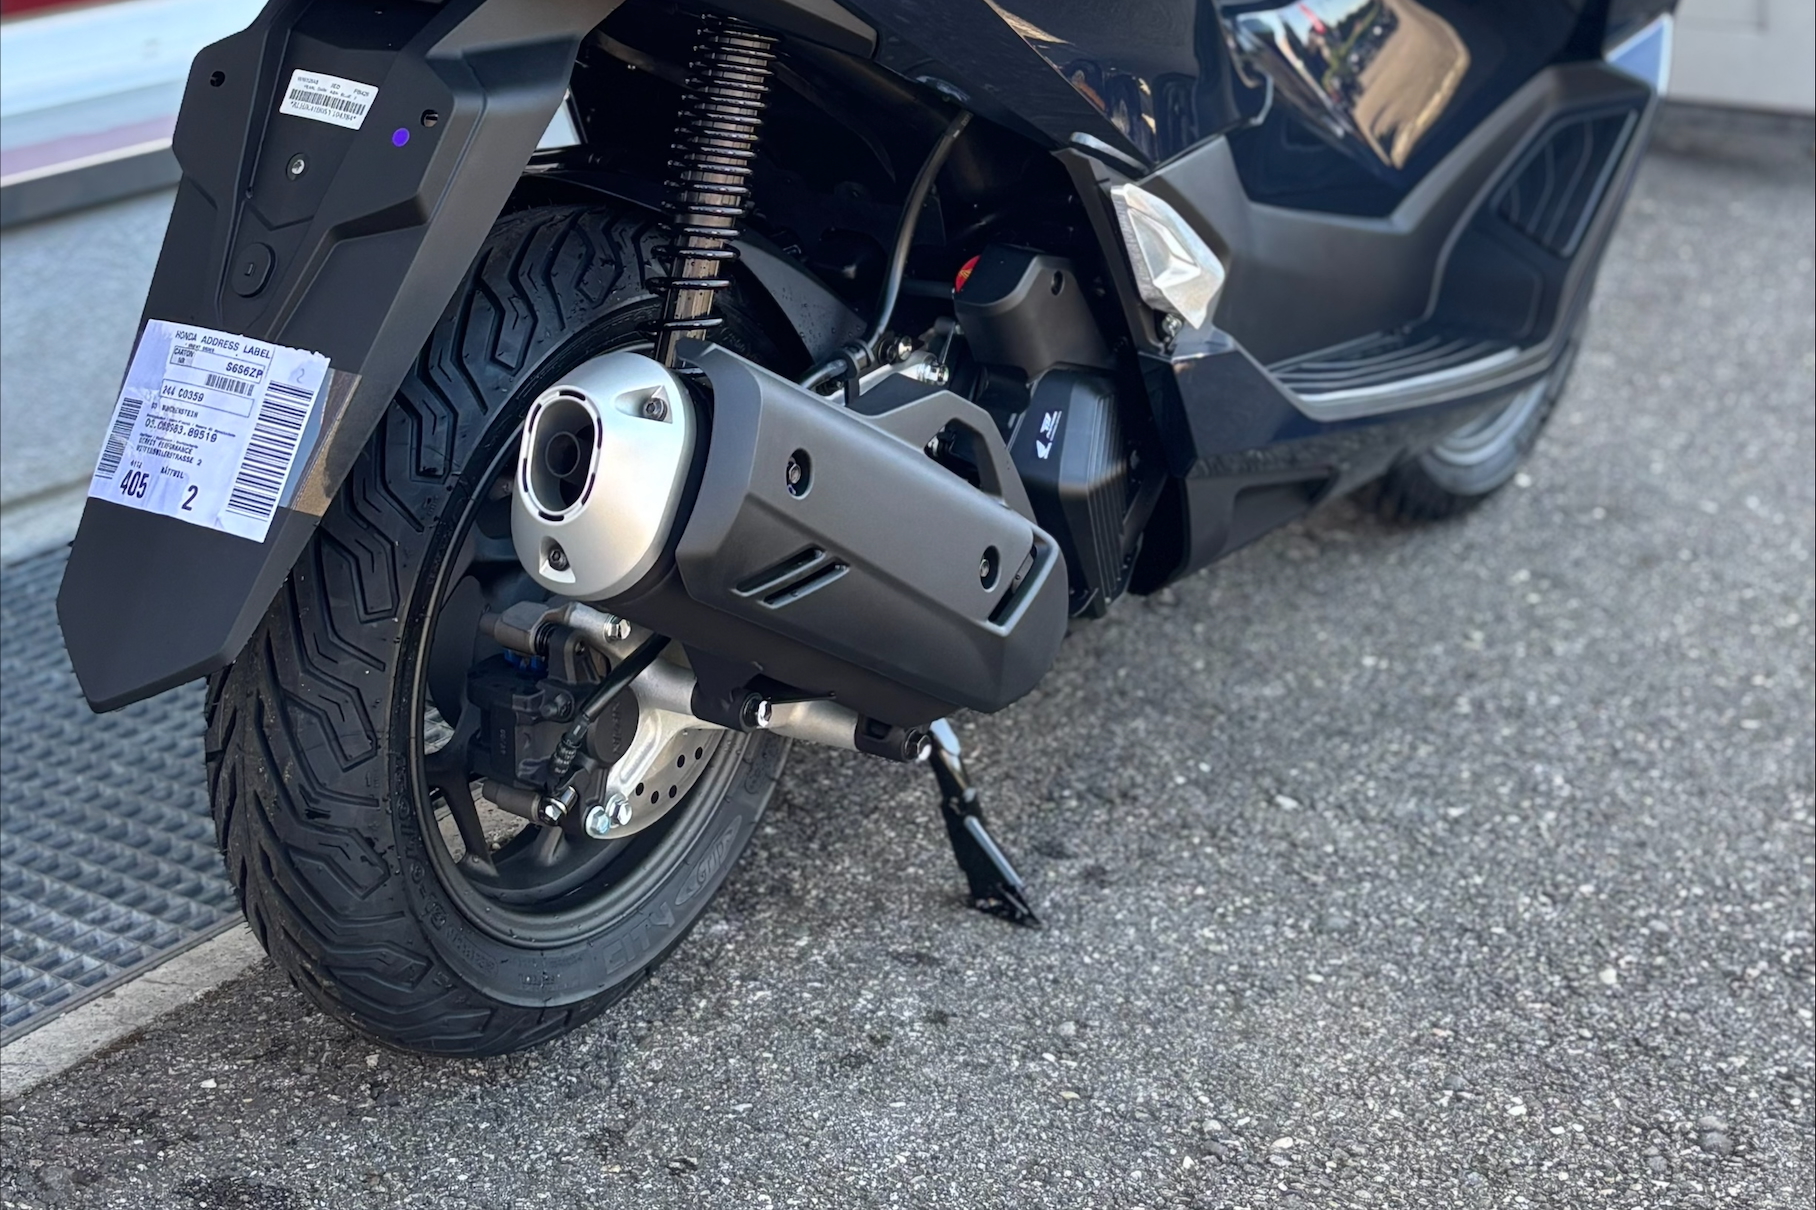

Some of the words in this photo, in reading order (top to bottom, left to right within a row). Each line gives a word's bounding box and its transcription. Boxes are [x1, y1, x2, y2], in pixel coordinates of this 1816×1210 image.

[175, 330, 197, 341] HONDA
[200, 335, 240, 351] ADDRESS
[243, 344, 271, 359] LABEL
[225, 361, 264, 379] S6S6ZP
[196, 458, 203, 466] 2
[120, 469, 150, 499] 405
[181, 484, 199, 511] 2
